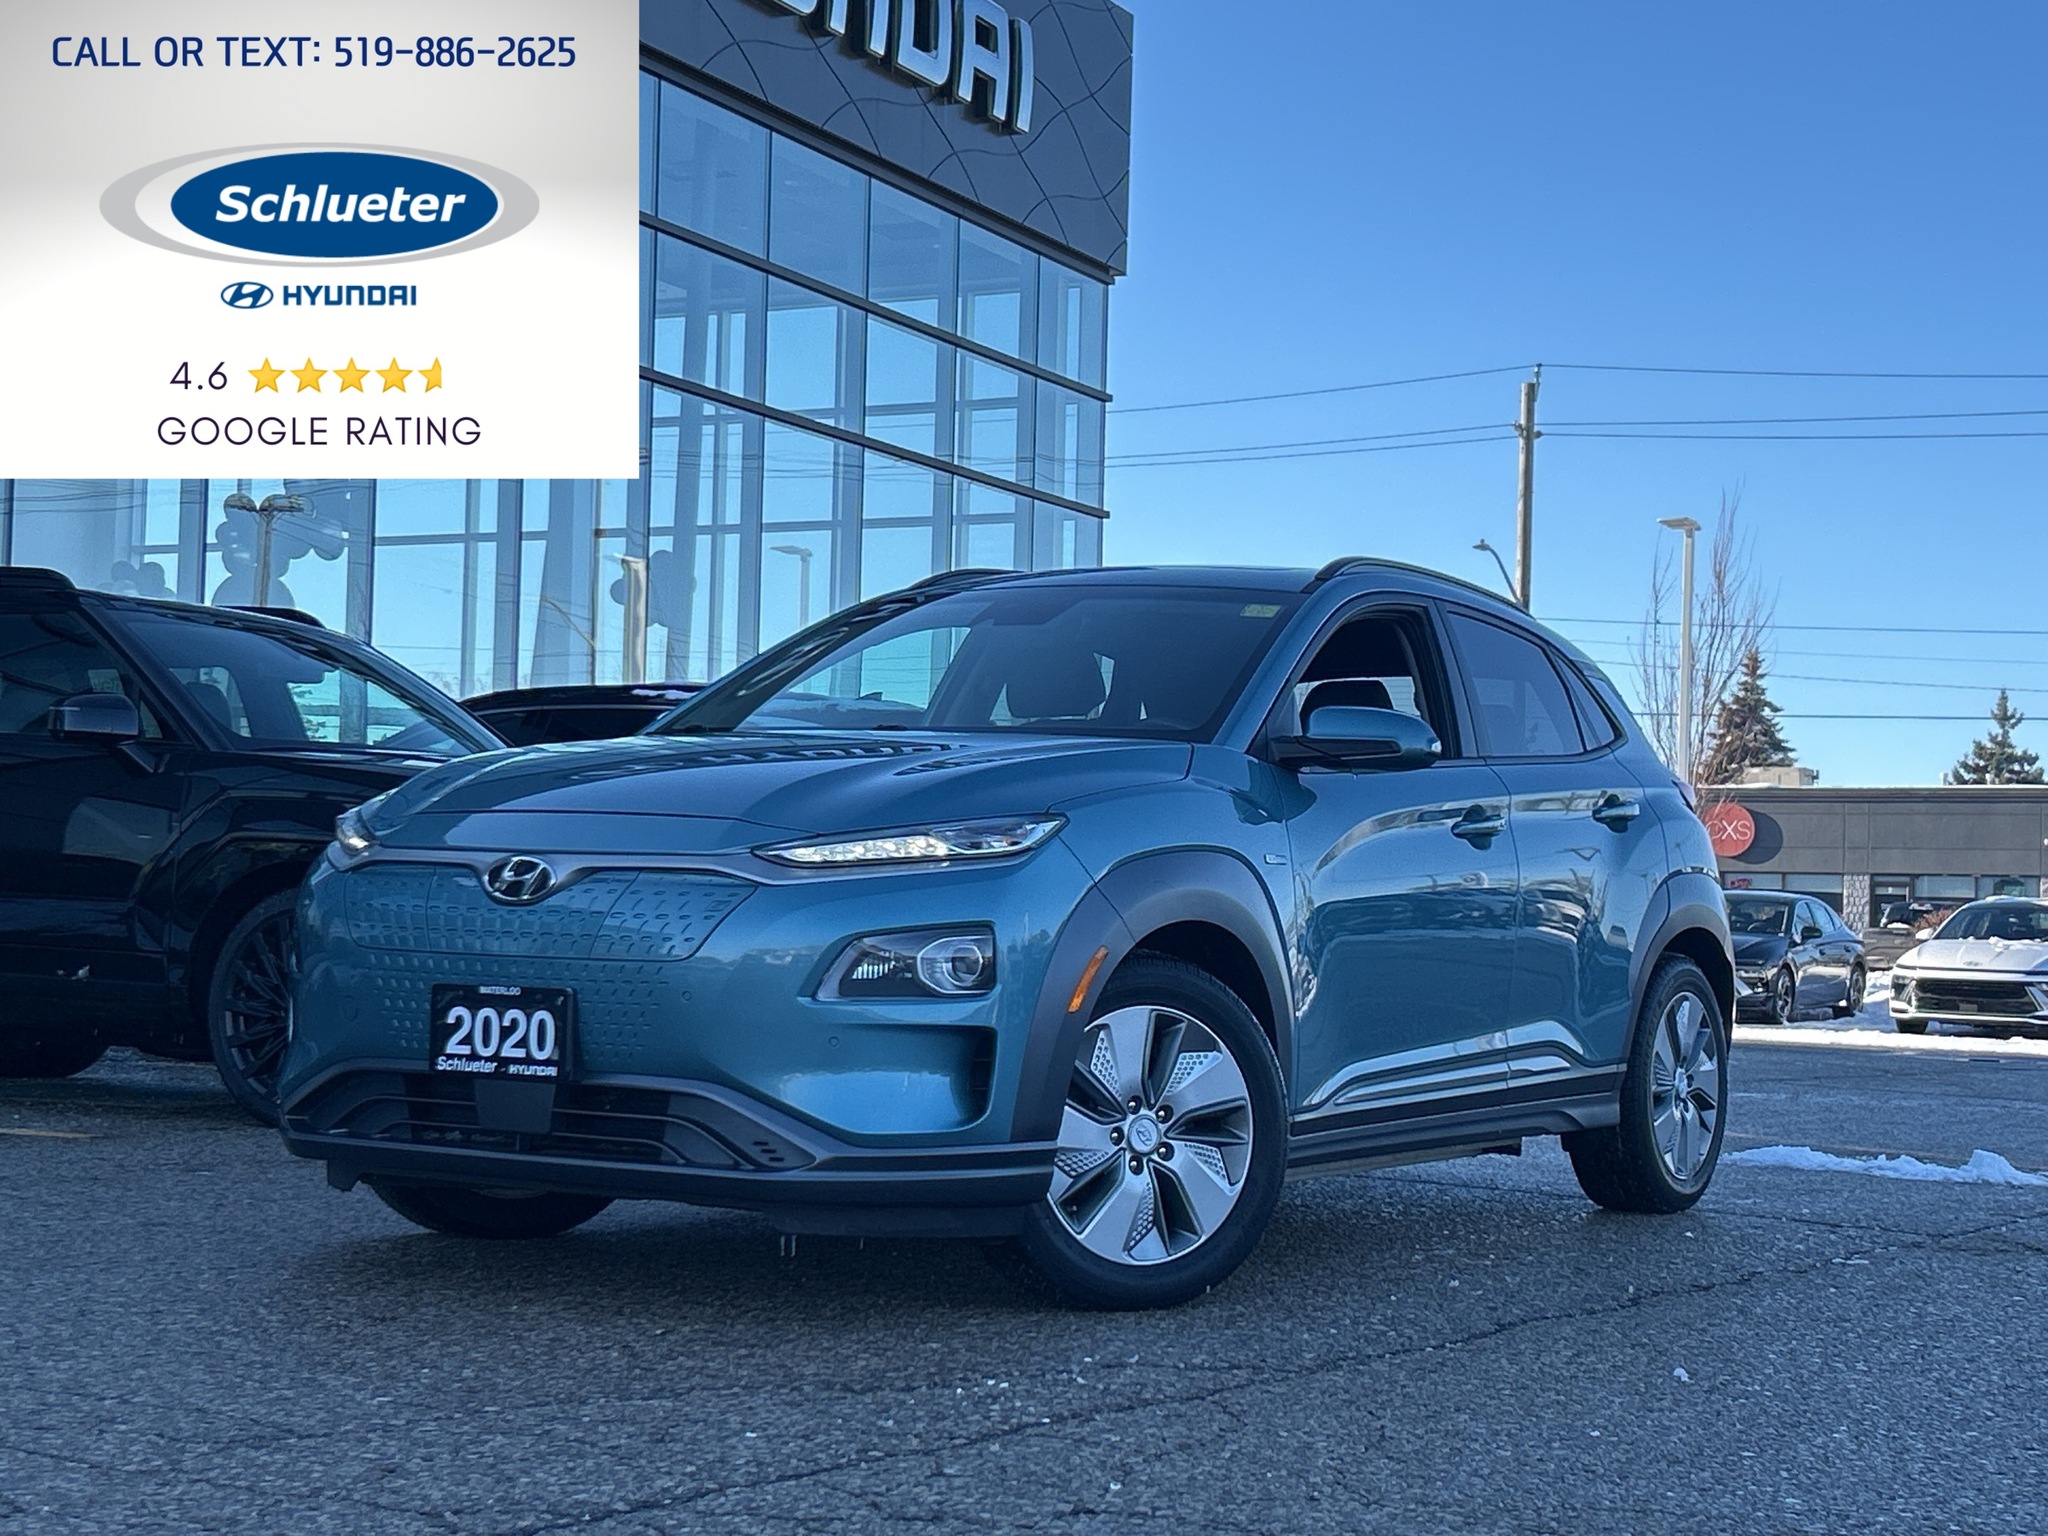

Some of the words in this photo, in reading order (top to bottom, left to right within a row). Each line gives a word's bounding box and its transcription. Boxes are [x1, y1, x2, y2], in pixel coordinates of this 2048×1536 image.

[445, 1006, 556, 1060] 2020
[436, 1056, 498, 1073] Schlueter
[508, 1064, 558, 1076] HYUNDAI
